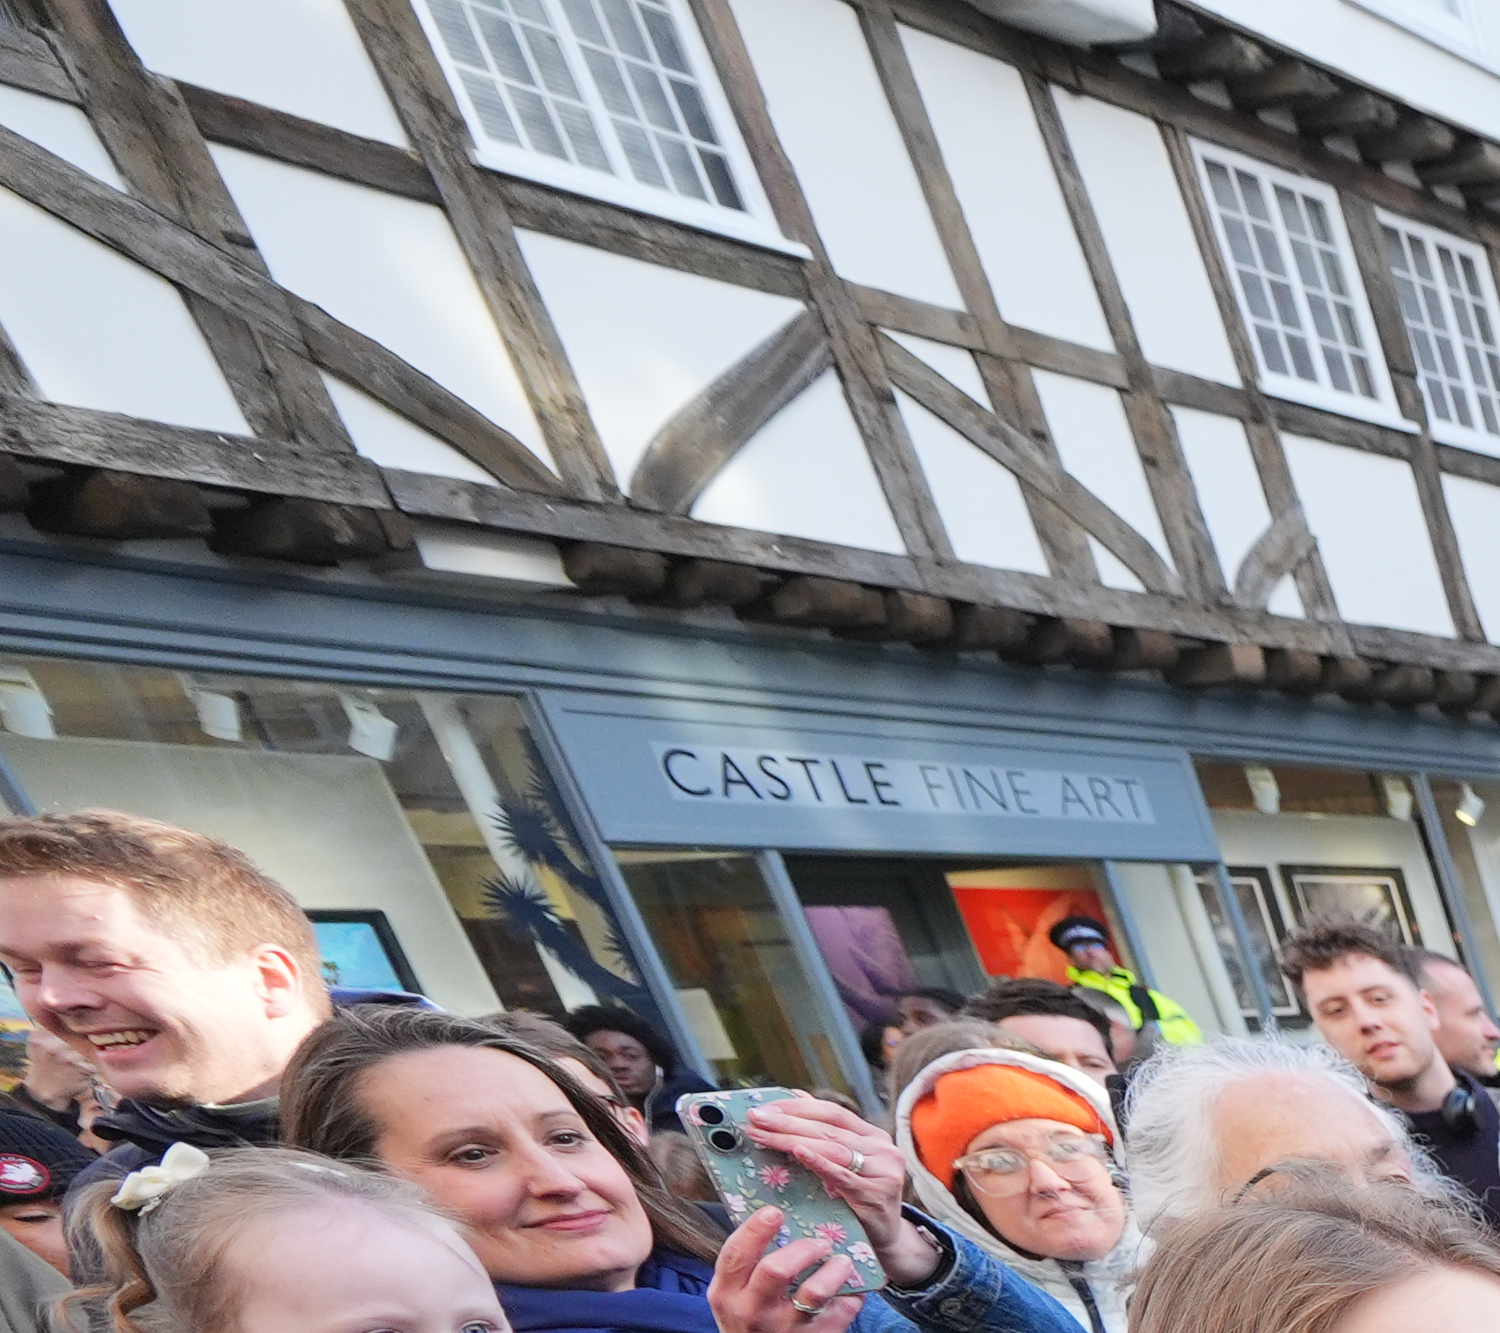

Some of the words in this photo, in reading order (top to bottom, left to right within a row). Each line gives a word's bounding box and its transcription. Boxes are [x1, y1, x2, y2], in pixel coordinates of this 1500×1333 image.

[662, 748, 900, 807] CASTLE
[919, 764, 1040, 815] FINE
[1059, 776, 1143, 819] ART
